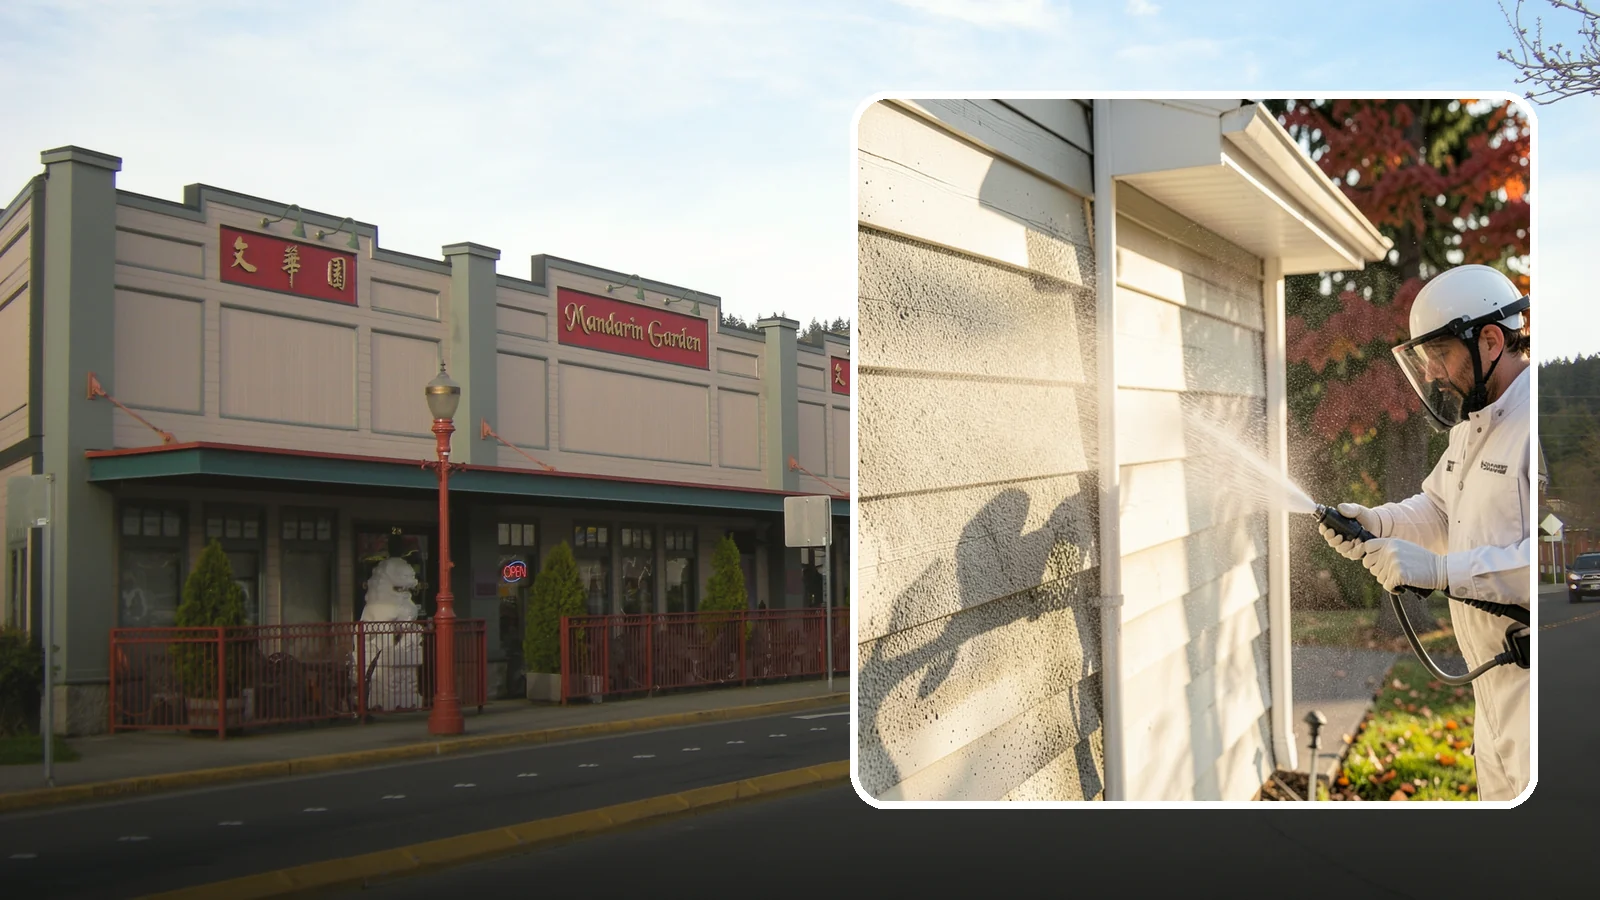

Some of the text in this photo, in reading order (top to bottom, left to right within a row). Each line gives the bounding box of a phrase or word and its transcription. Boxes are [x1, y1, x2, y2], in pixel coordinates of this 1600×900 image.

[565, 302, 701, 352] Mandarin Garden
[834, 363, 846, 386] 文
[503, 565, 527, 578] OPEN
